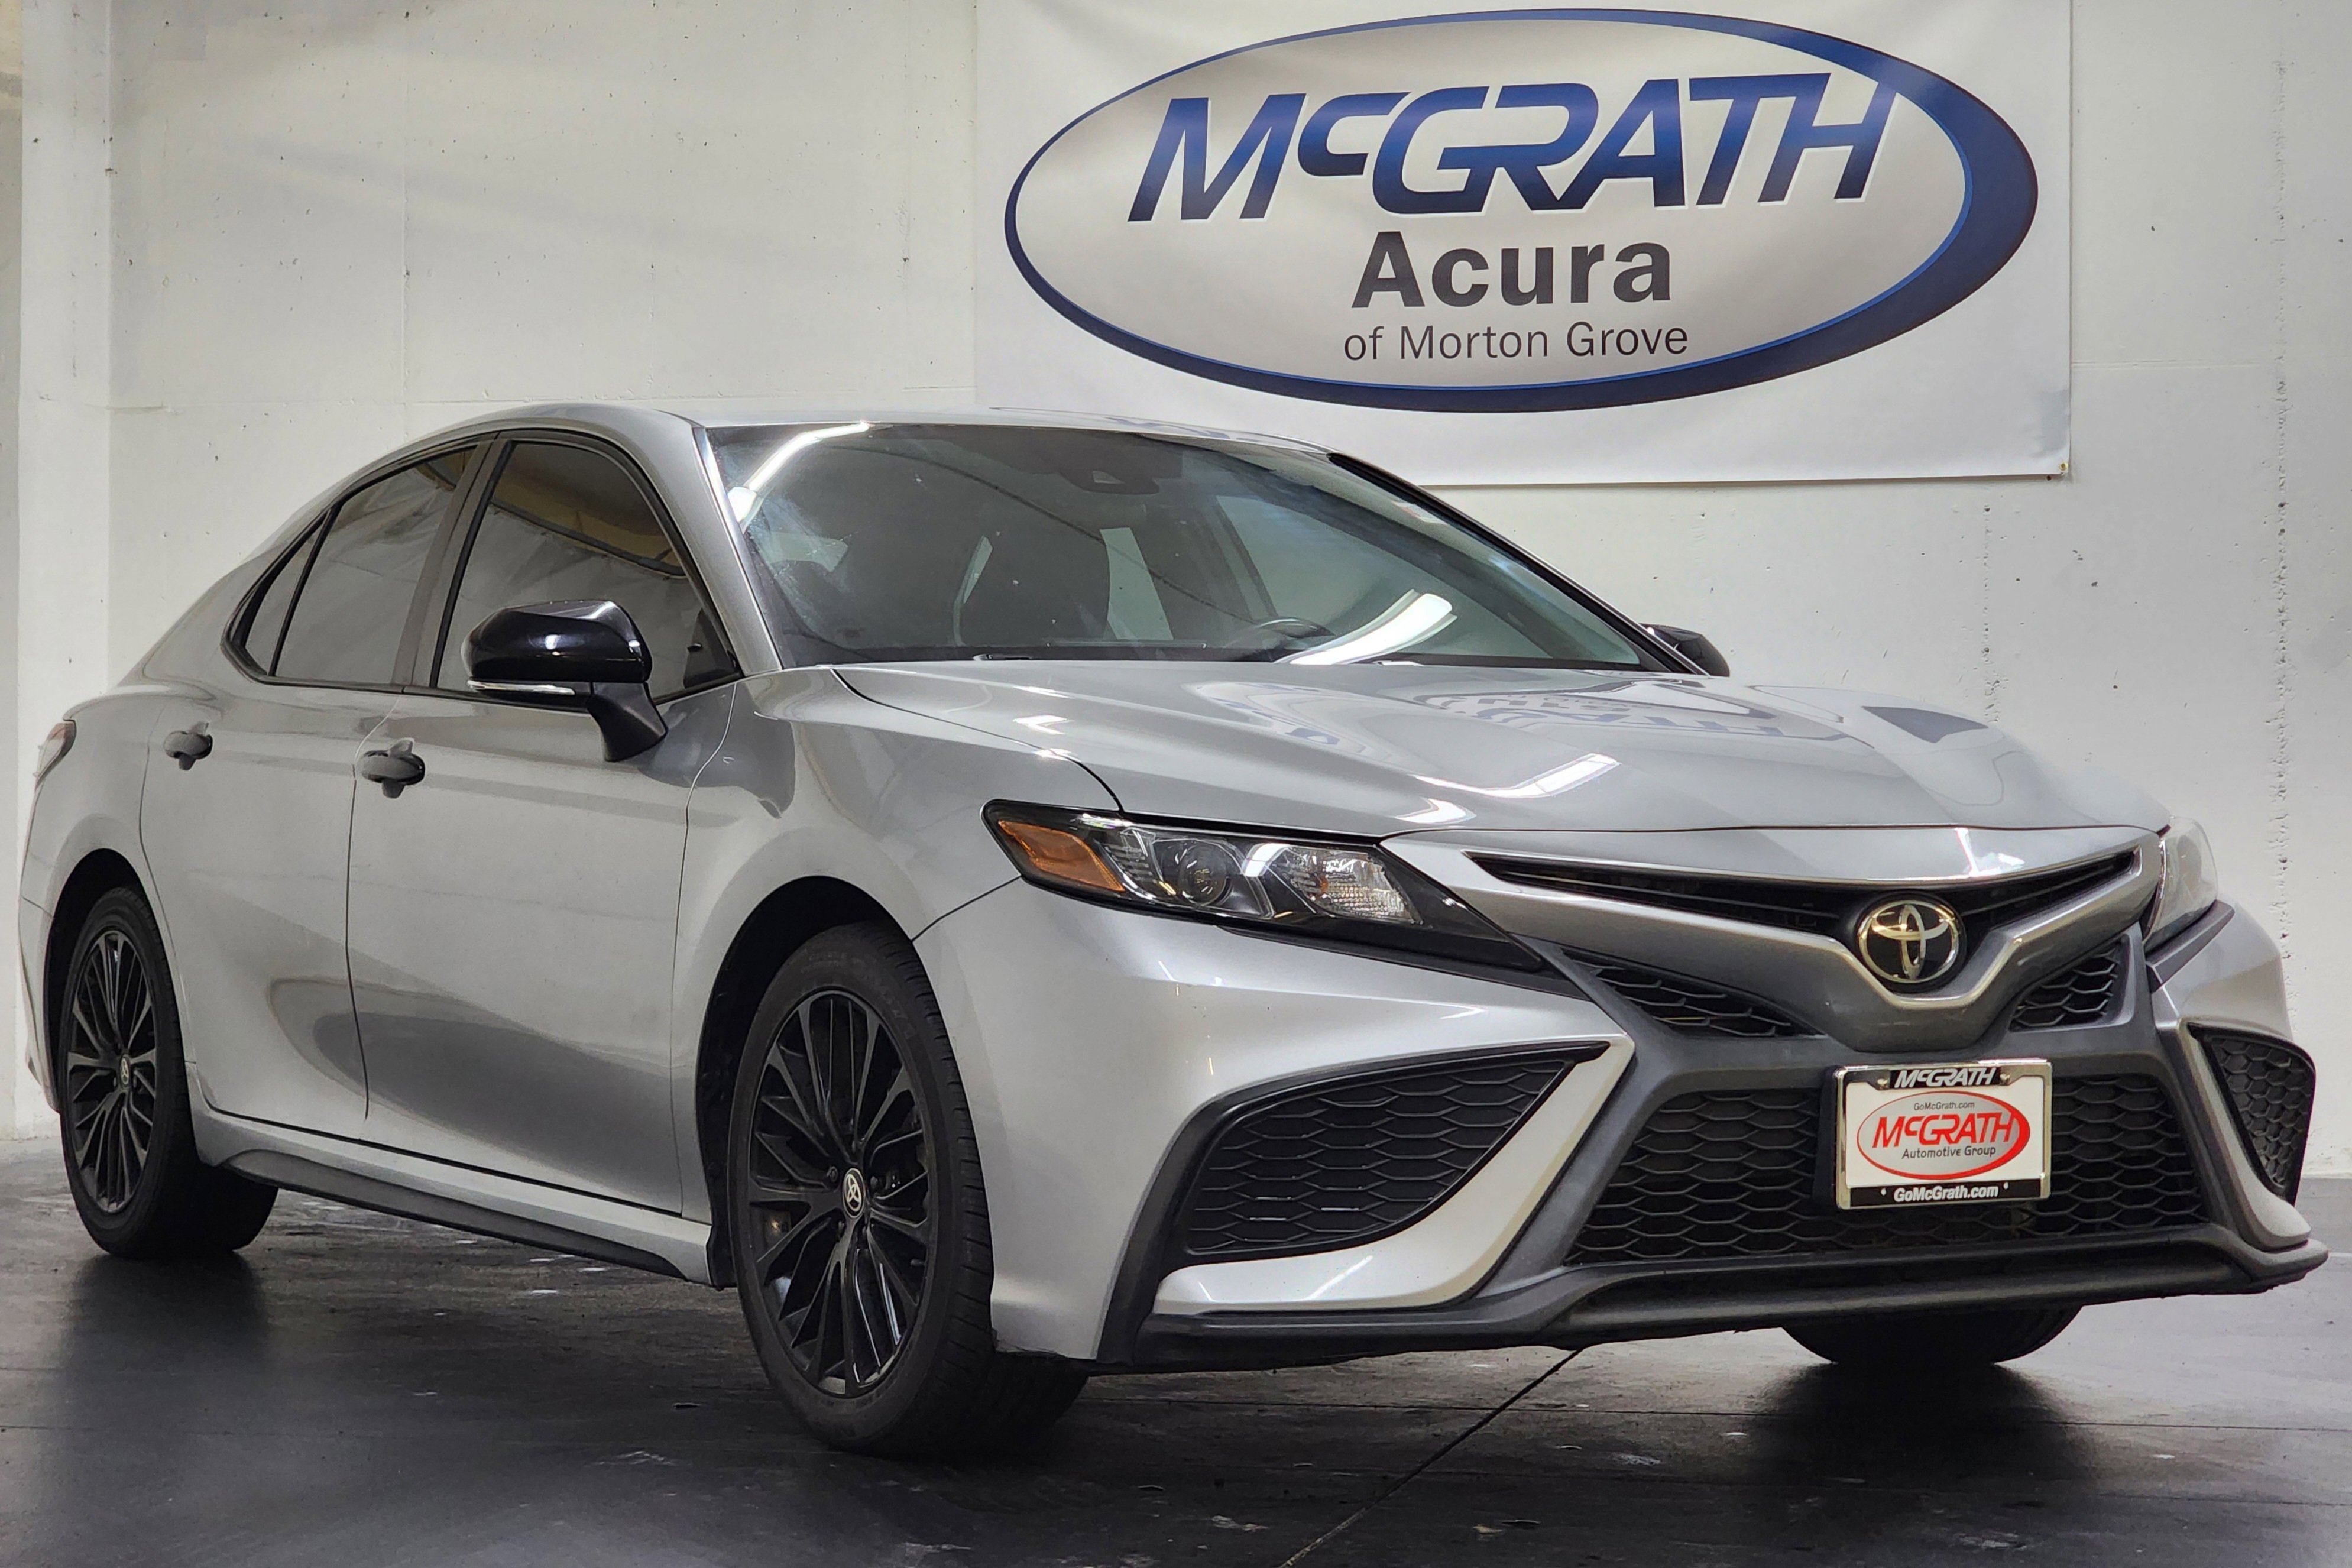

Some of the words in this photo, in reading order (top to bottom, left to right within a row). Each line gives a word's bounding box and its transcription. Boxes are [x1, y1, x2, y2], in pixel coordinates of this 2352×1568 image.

[1350, 230, 1671, 309] Acura
[1343, 326, 1384, 361] of
[1399, 325, 1549, 359] Morton
[1566, 320, 1689, 357] Grove
[1913, 1102, 1975, 1111] GoMcGrath.com
[1901, 1146, 1961, 1159] Automotive
[1964, 1146, 1996, 1158] Group
[1894, 1185, 1998, 1203] GoMcGrath.com
